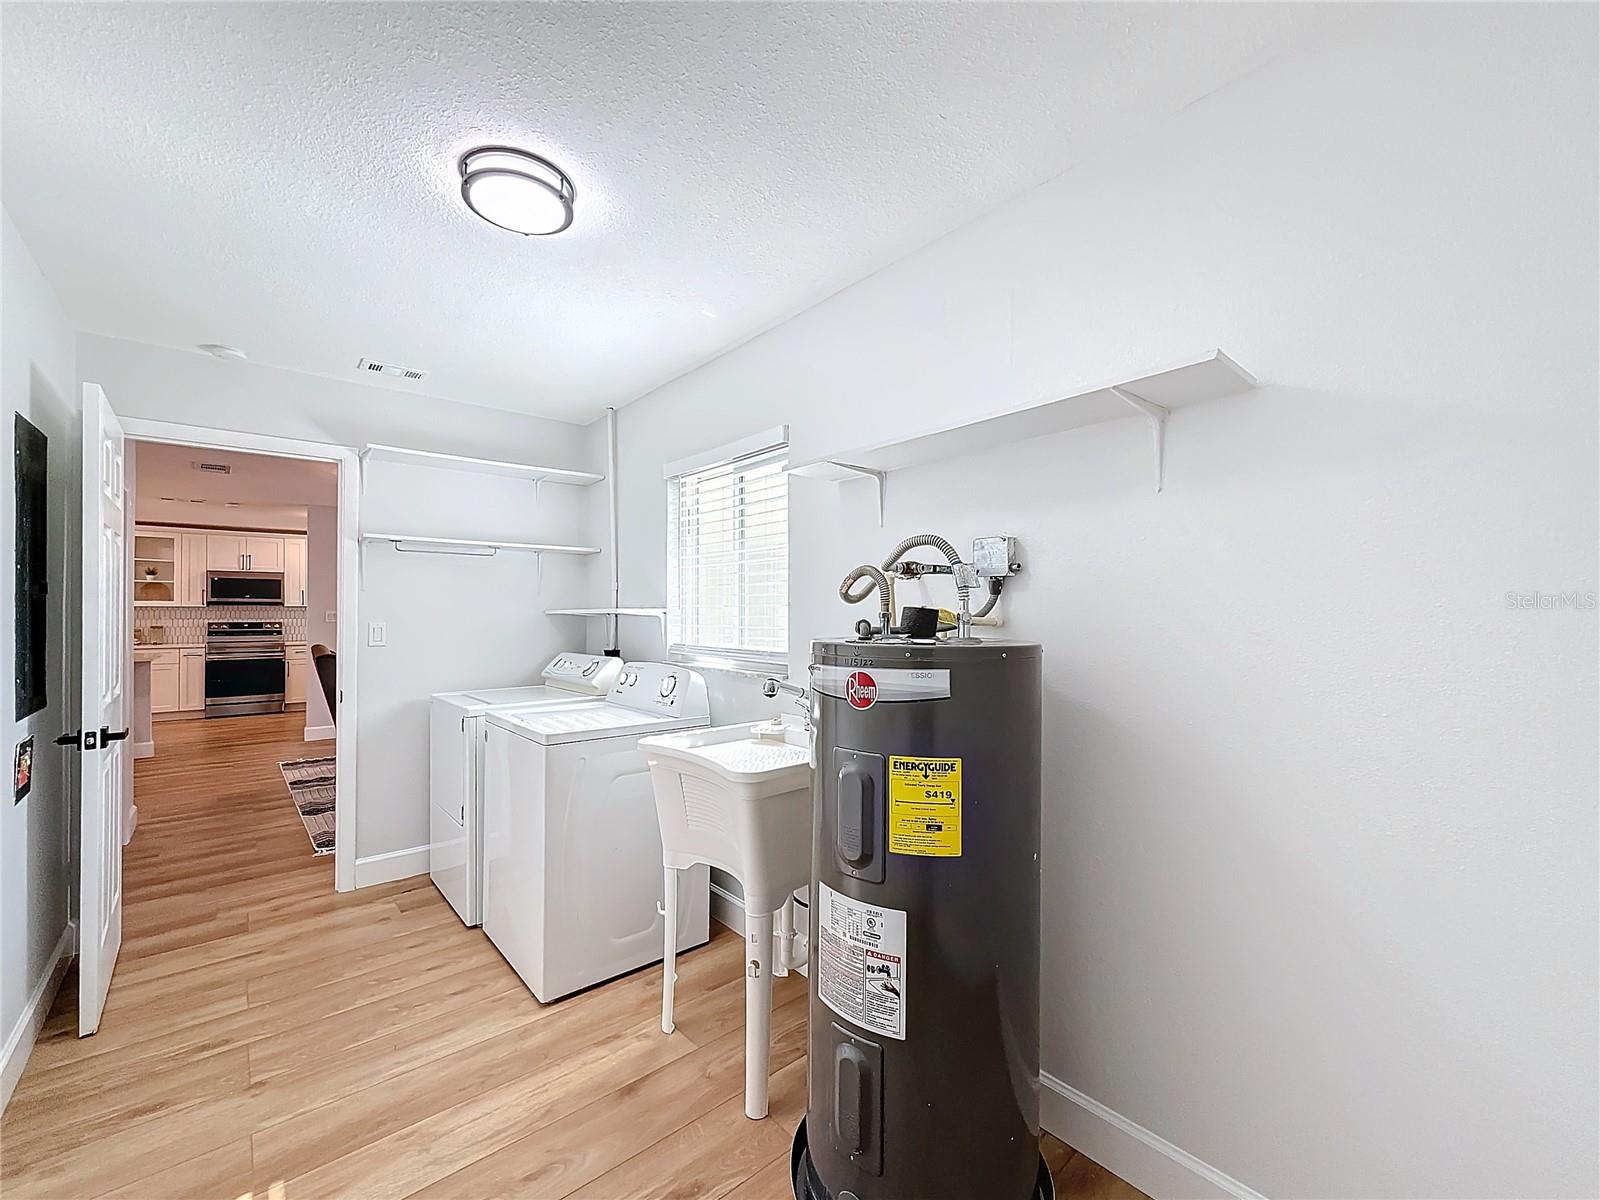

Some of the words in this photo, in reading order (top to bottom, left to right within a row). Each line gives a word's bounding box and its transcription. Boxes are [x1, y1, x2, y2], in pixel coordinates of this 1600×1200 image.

[848, 671, 876, 704] Rheem
[893, 760, 957, 772] ENERGYGUIDE
[924, 790, 952, 799] $419
[872, 952, 899, 963] DANGER
